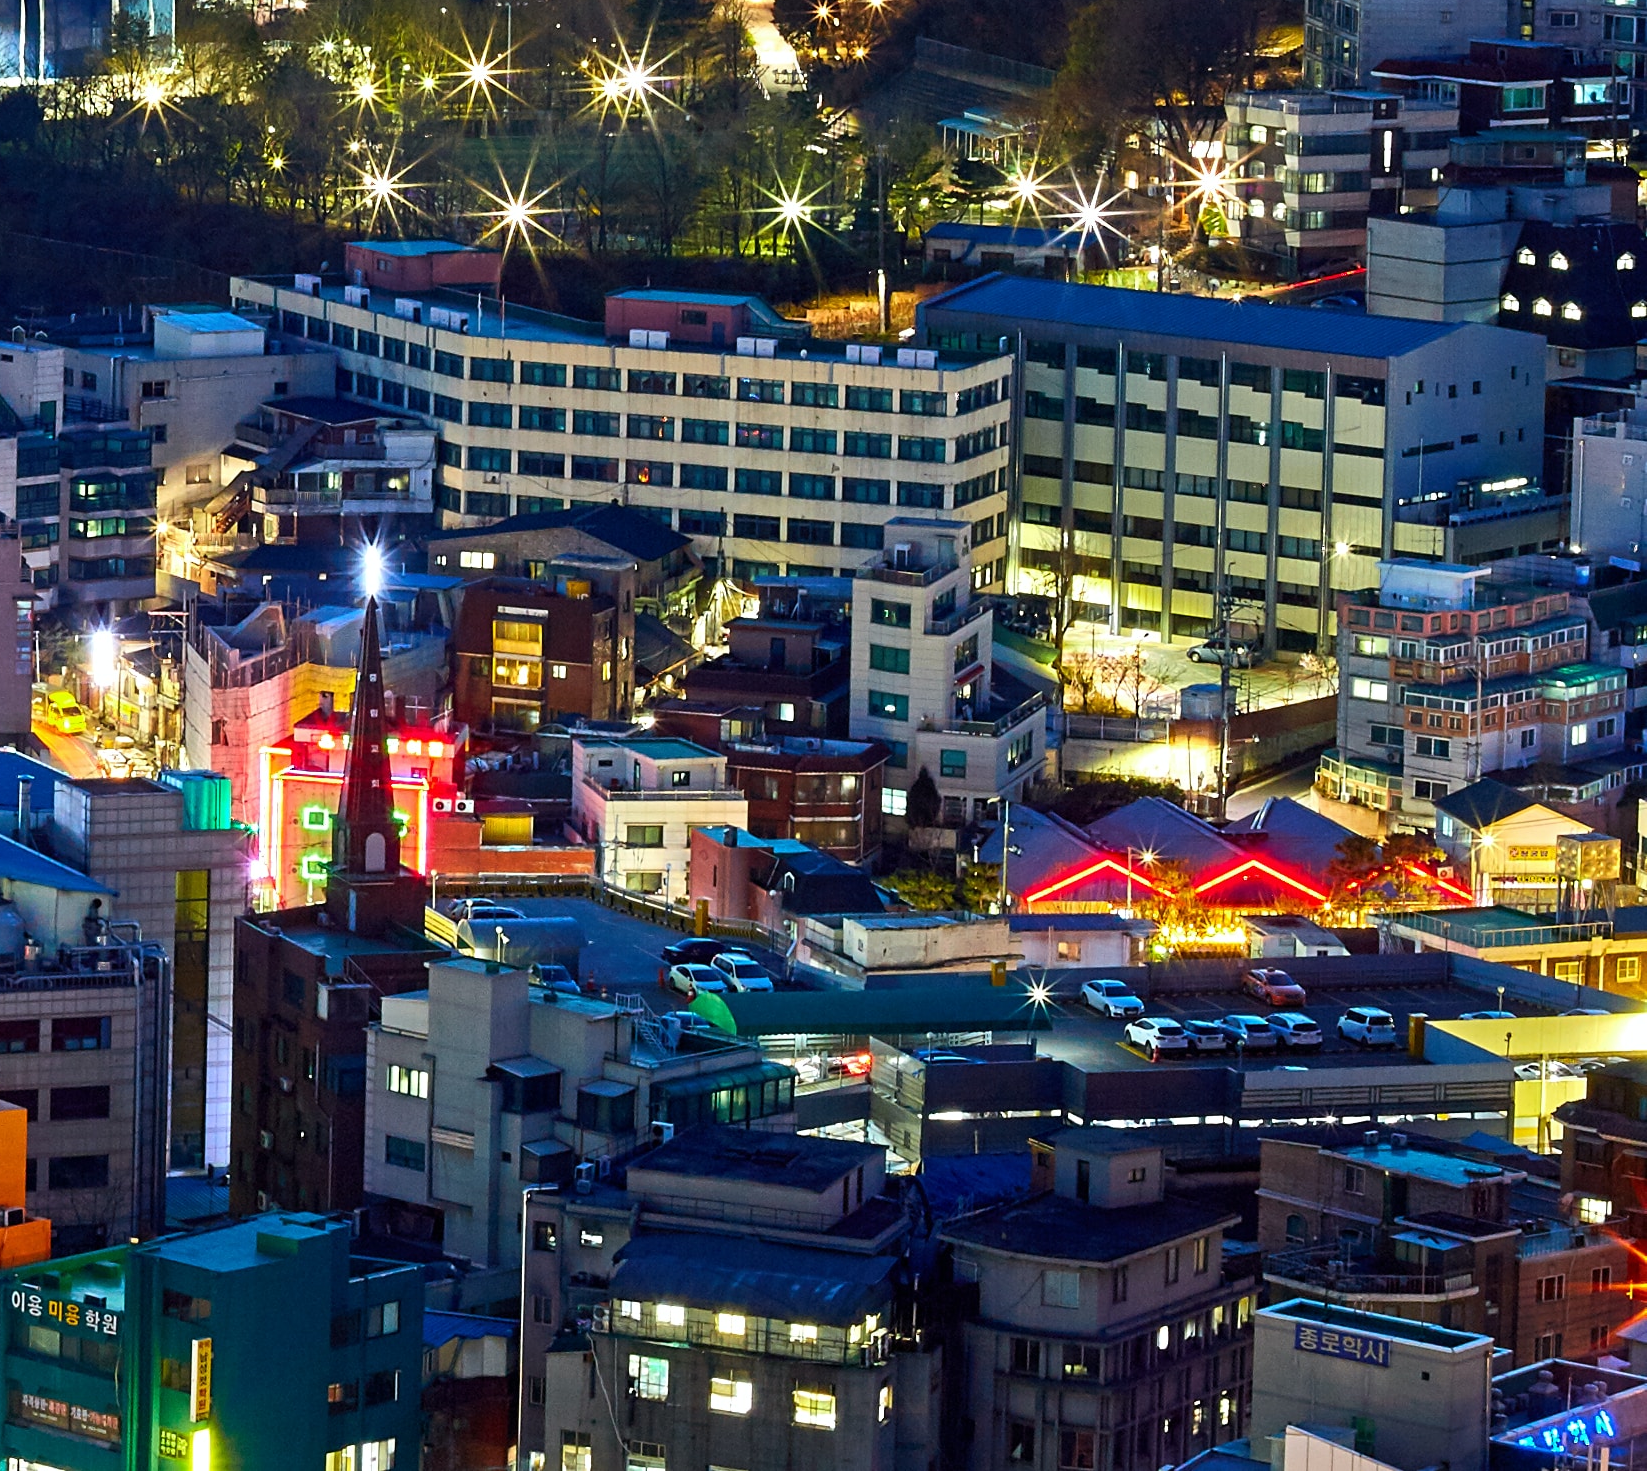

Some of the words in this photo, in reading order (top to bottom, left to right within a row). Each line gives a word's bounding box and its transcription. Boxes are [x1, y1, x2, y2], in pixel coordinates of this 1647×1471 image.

[11, 1291, 43, 1317] 이용
[48, 1300, 81, 1326] 미용
[85, 1309, 117, 1335] 학원
[1299, 1327, 1385, 1363] 종로학사
